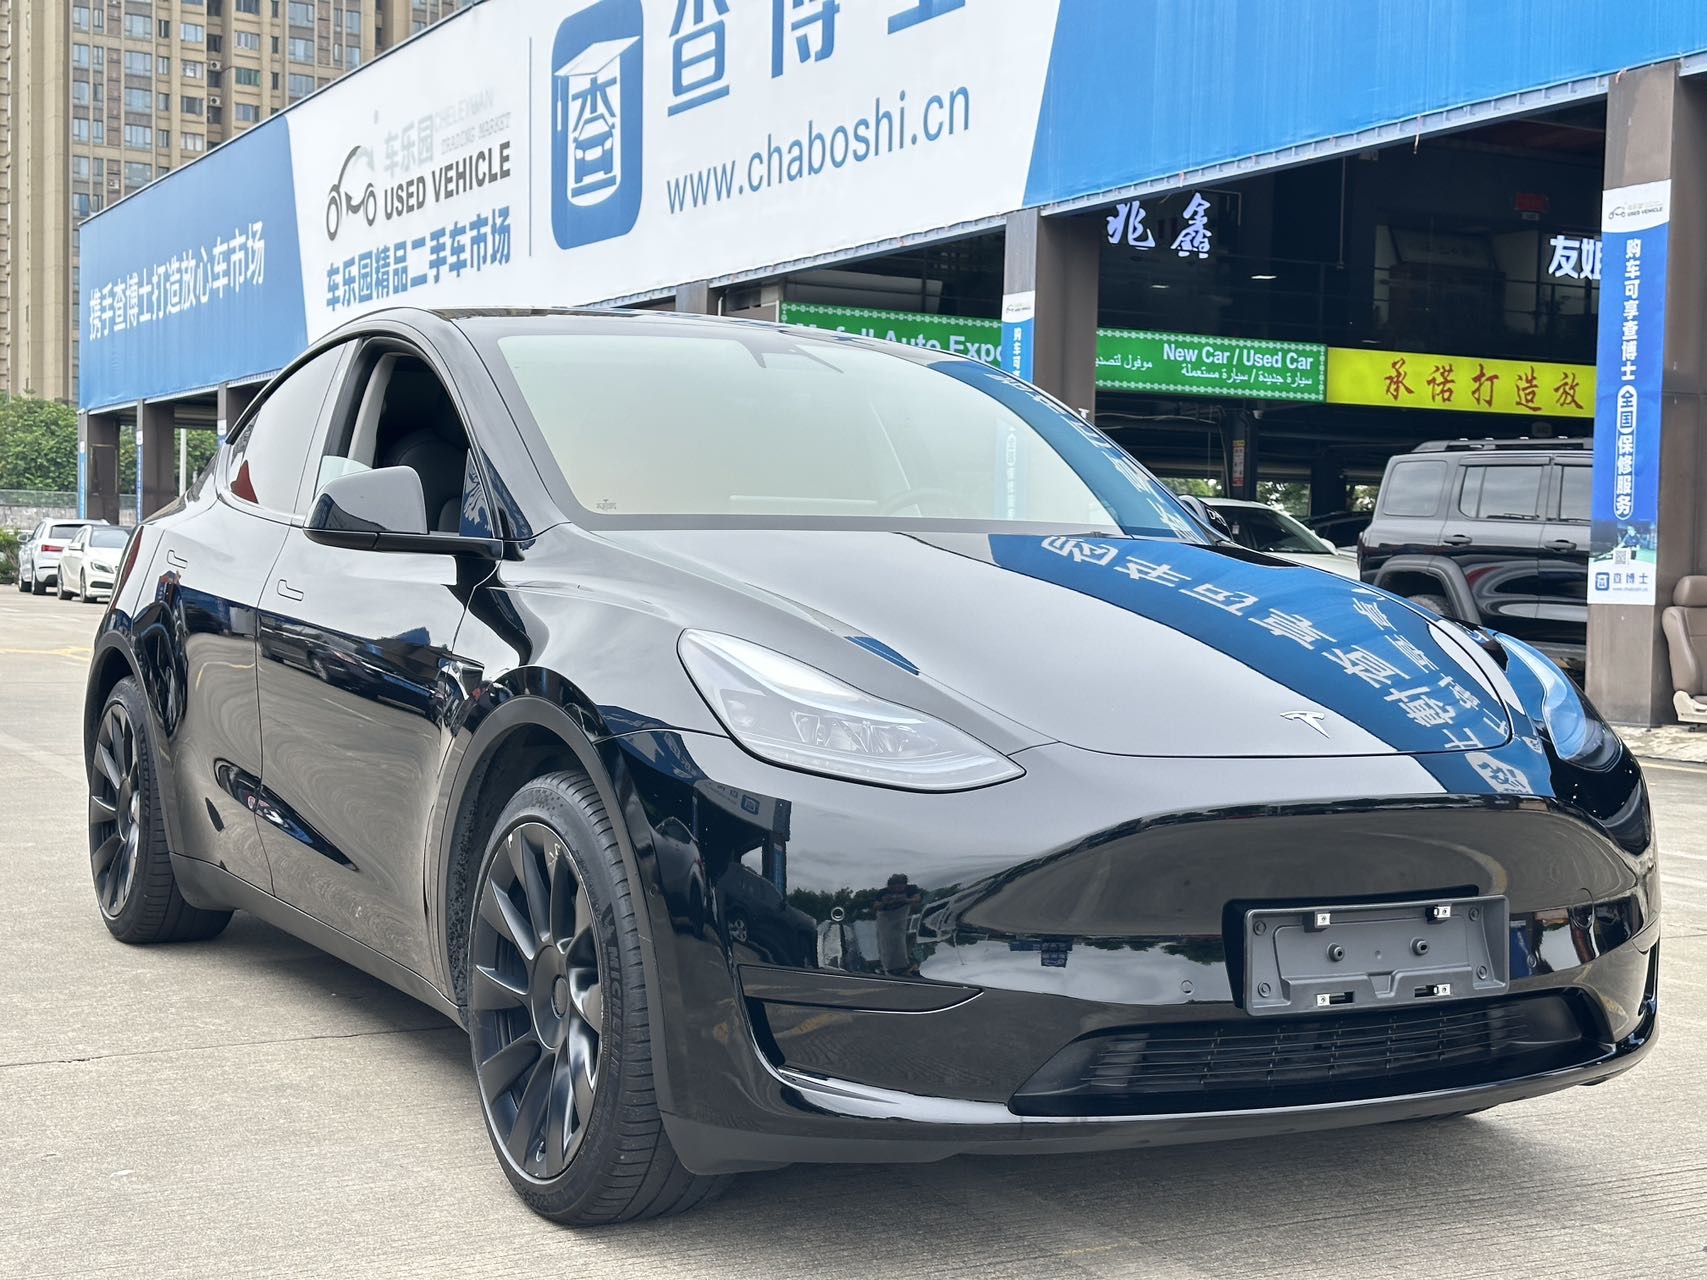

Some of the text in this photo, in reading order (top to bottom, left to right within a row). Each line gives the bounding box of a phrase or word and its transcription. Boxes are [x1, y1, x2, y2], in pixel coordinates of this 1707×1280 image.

[384, 140, 510, 220] USED VEHICLE
[666, 85, 970, 215] www.chaboshi.cn
[89, 220, 265, 341] 携手查博士打造放心车市场
[326, 206, 511, 312] 车乐园精品二手车市场
[1620, 238, 1642, 381] 购车可享查博士
[1163, 343, 1314, 371] New Car / Used Car
[1181, 363, 1220, 379] مستعملة
[1222, 367, 1248, 383] سيارة
[1258, 370, 1285, 386] جديدة
[1286, 372, 1313, 388] سيارة
[1383, 357, 1585, 412] 承诺打造放
[1615, 389, 1635, 516] 全国保修服务
